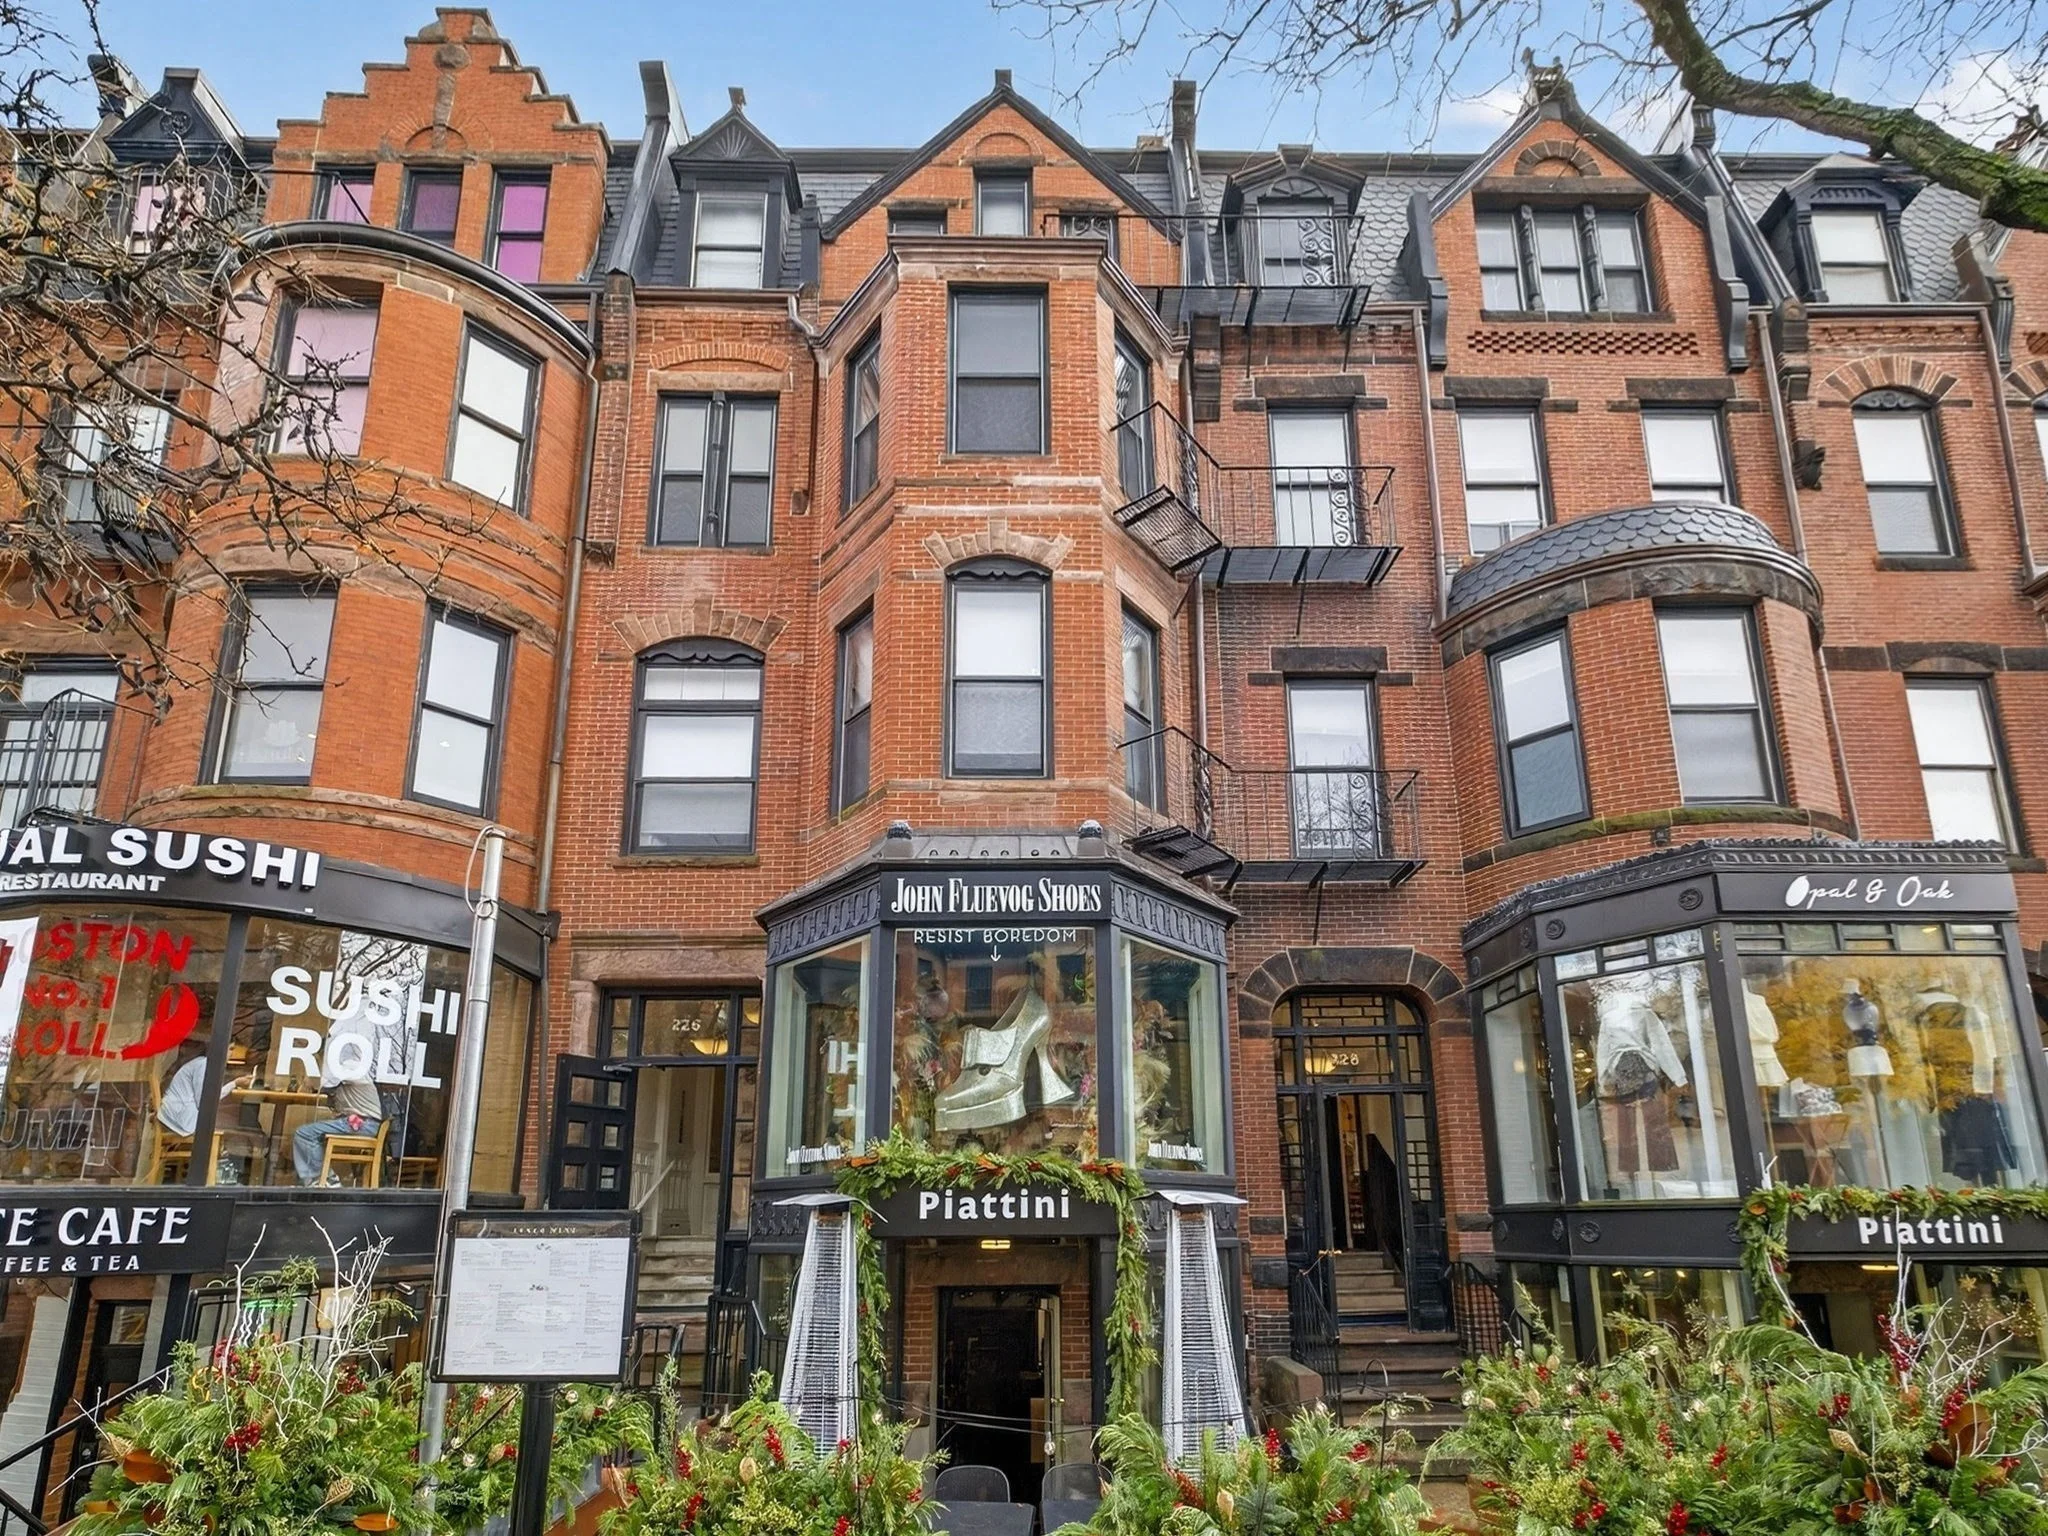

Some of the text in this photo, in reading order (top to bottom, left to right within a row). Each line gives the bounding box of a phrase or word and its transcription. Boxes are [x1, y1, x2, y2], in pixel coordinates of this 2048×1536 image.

[107, 828, 320, 888] SUSHI
[0, 872, 165, 892] RESTAURANT
[891, 877, 1101, 913] JOHN FLUEVOG SHOES
[1785, 875, 1954, 909] Opal & Oak
[914, 928, 1077, 943] RESIST BOREDOM
[266, 966, 461, 1035] SUSHI
[672, 1018, 701, 1031] 226
[275, 1026, 441, 1089] ROLL
[919, 1188, 1070, 1219] Piattini
[0, 1207, 192, 1246] E CAFE
[1858, 1215, 2004, 1245] Piattini
[0, 1255, 140, 1273] FEE & TEA
